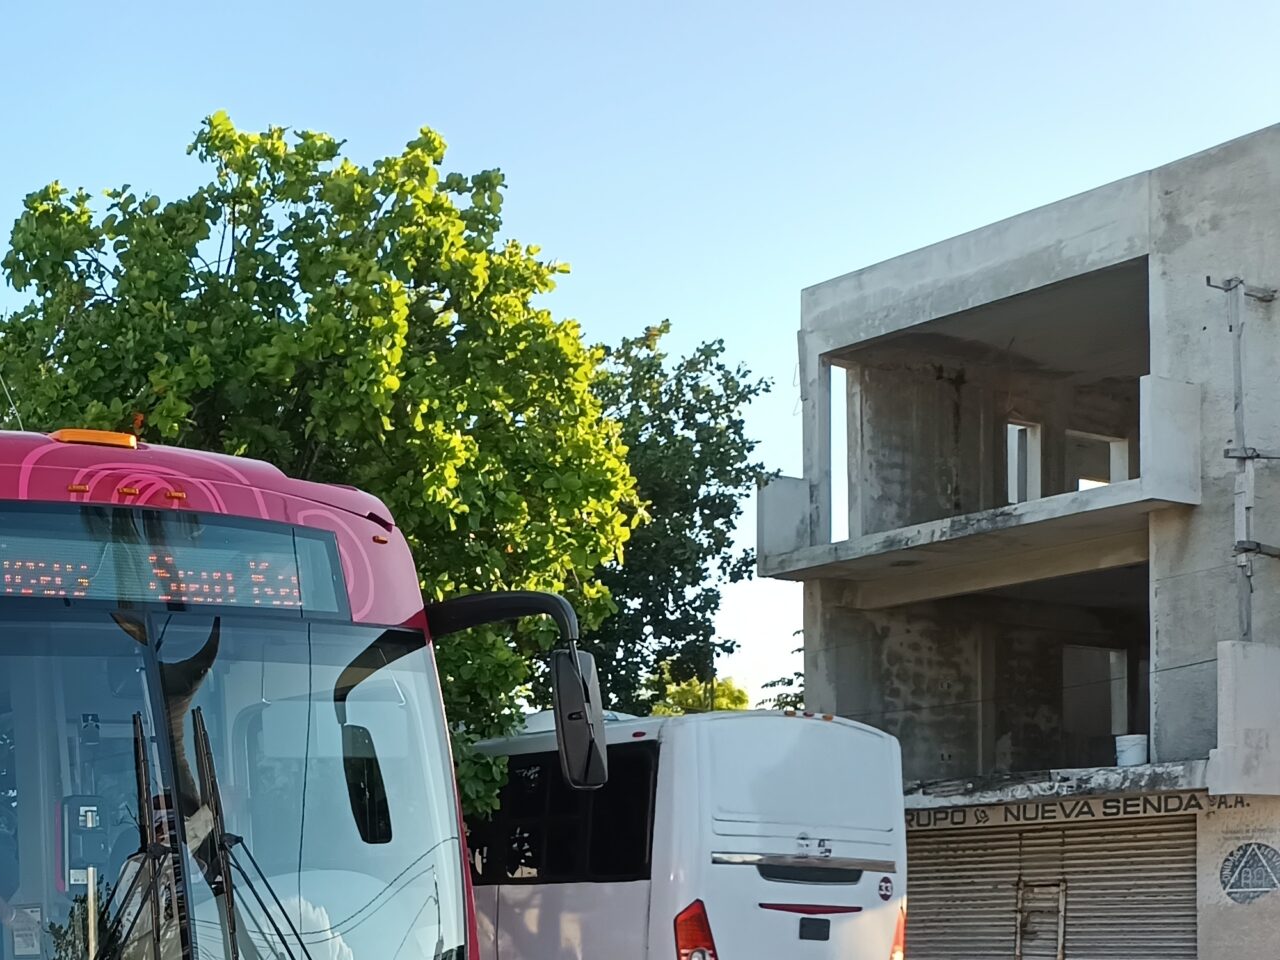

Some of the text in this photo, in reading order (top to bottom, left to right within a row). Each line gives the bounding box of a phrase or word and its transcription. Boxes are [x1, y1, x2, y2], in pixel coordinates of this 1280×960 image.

[1003, 801, 1096, 823] NUEVA
[1102, 794, 1204, 817] SENDA
[878, 882, 893, 896] 33
